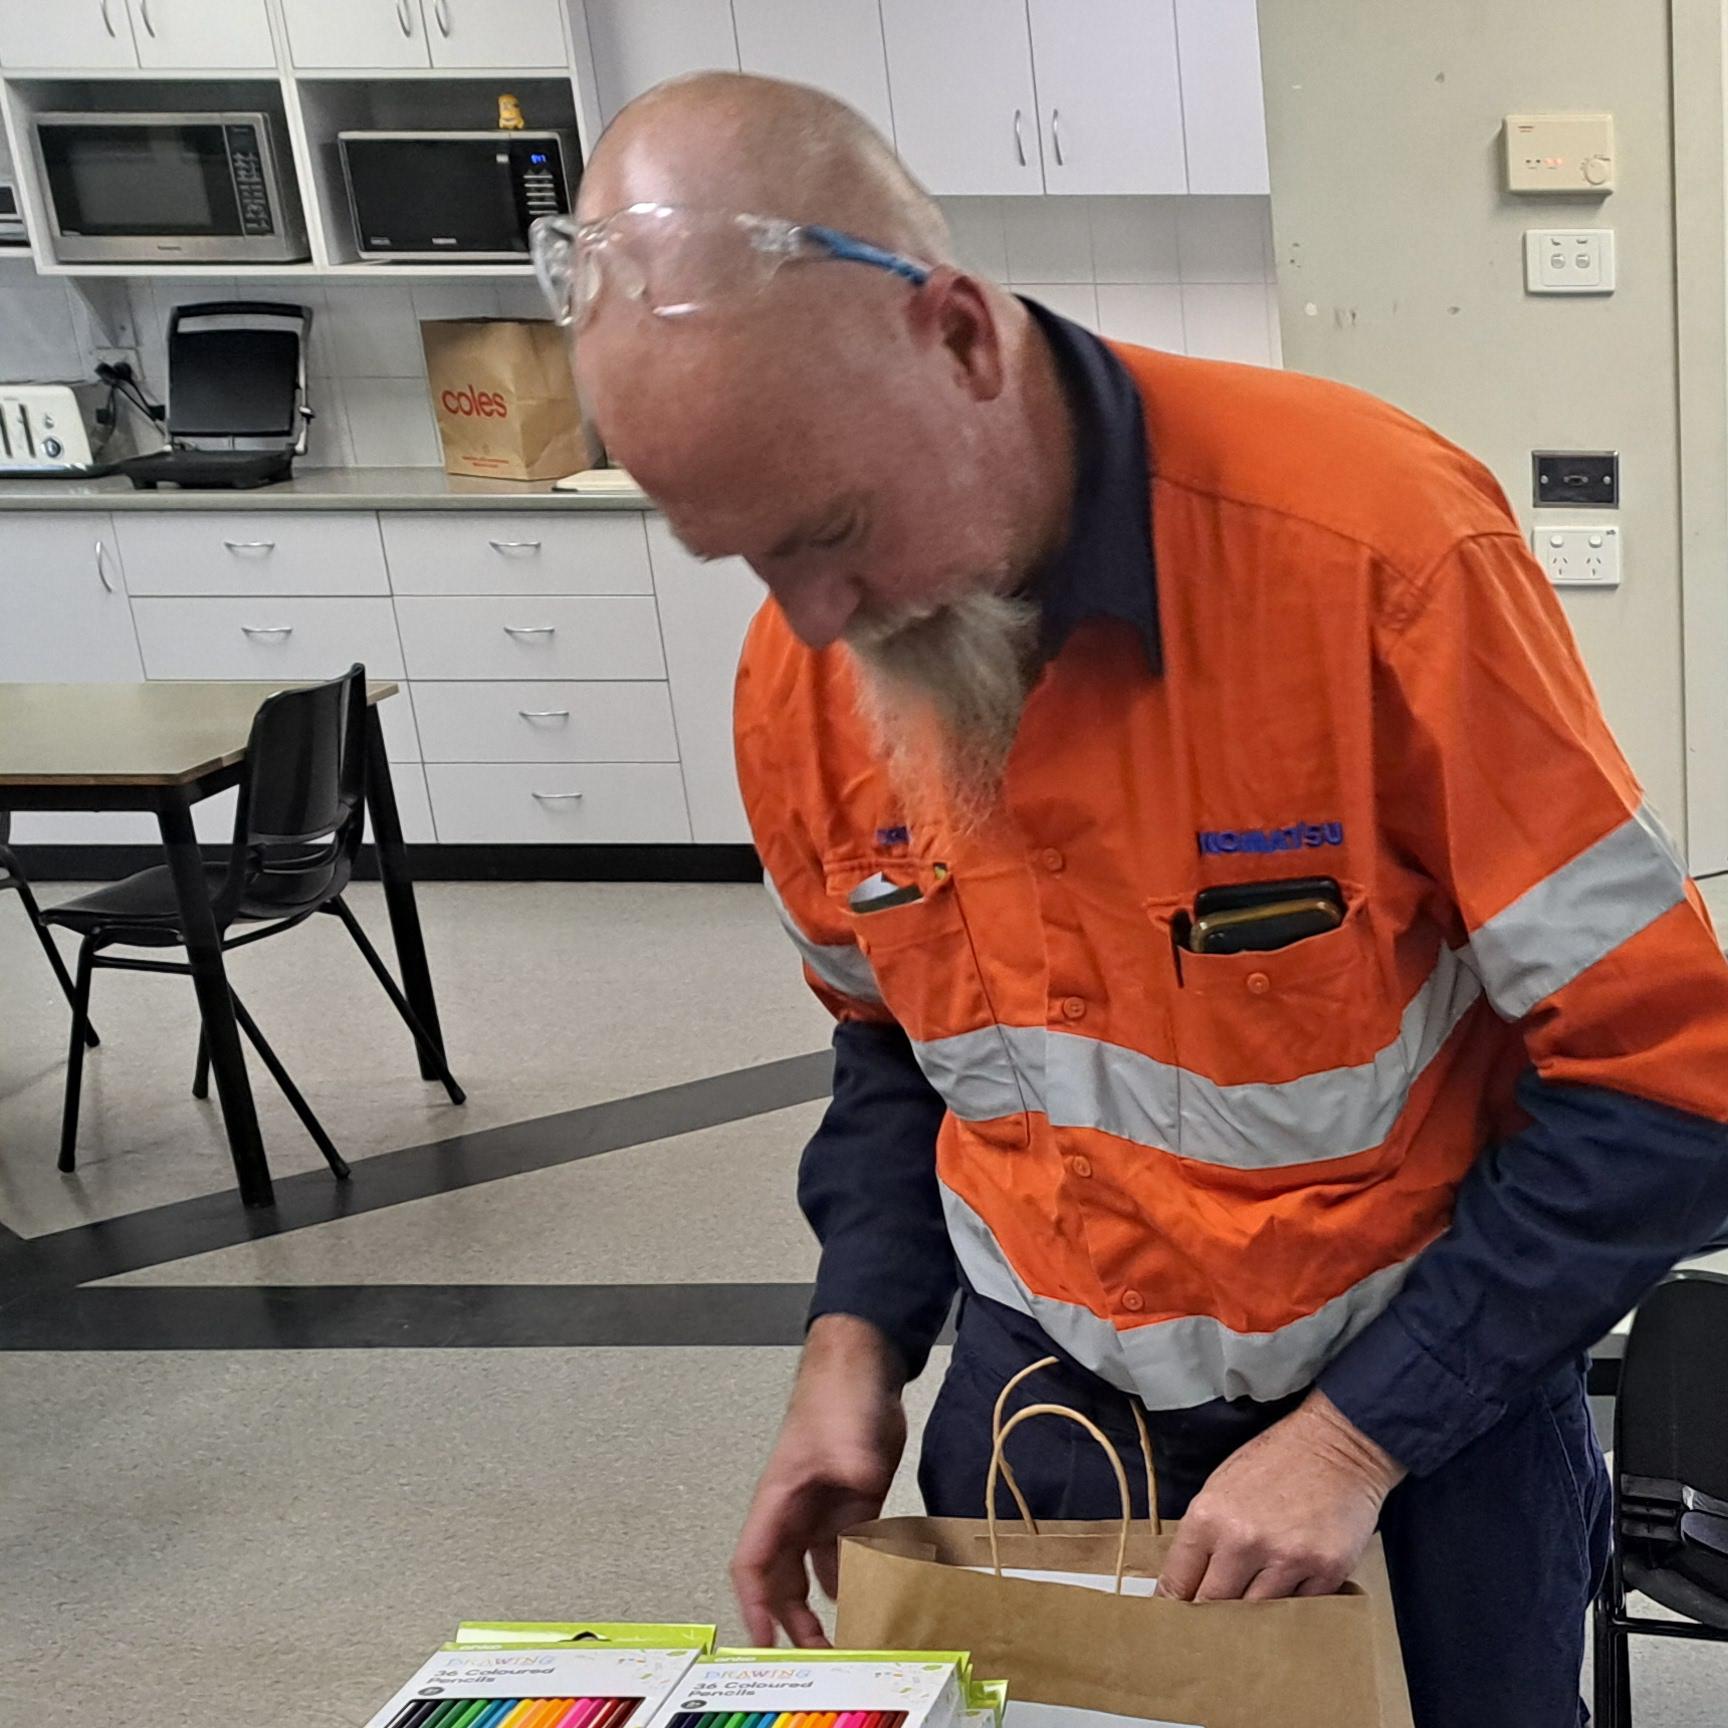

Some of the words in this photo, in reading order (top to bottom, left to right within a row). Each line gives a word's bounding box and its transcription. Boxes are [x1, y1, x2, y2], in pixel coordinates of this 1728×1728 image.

[442, 385, 508, 418] coles
[1198, 822, 1343, 855] KOMATSU
[434, 1669, 458, 1677] 36
[465, 1667, 556, 1675] Coloured
[426, 1676, 496, 1684] Pencils
[694, 1682, 717, 1690] 36
[724, 1681, 814, 1689] Coloured
[688, 1688, 755, 1697] Pencils
